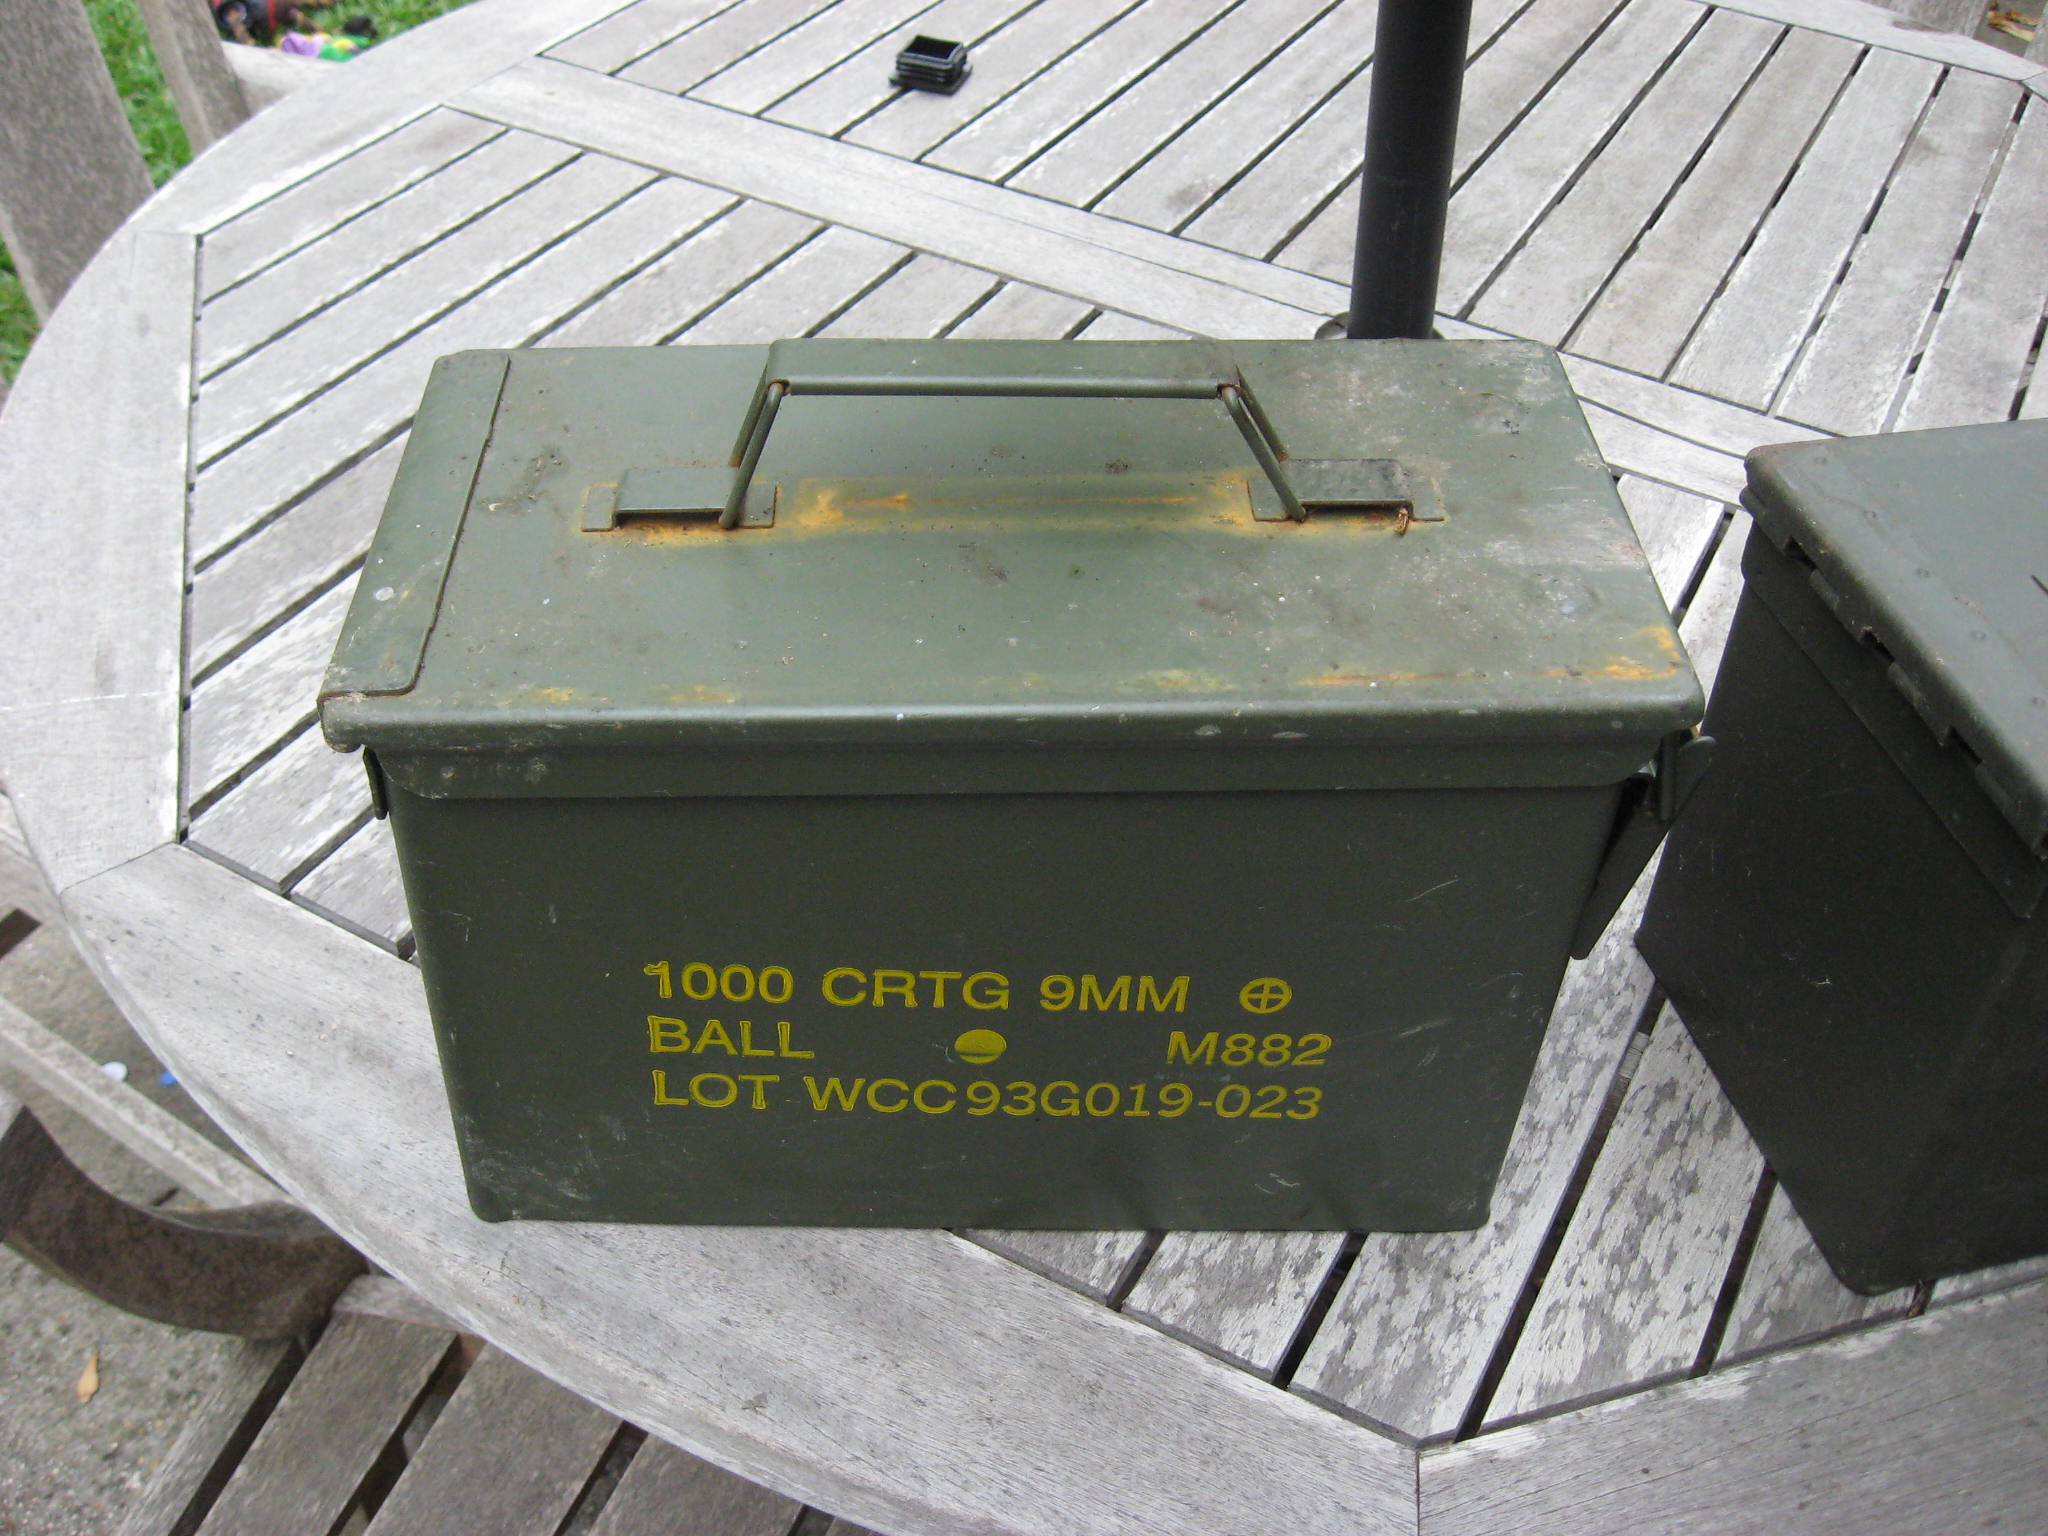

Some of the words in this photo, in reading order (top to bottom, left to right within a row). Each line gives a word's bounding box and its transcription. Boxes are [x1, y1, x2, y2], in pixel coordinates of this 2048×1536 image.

[642, 960, 795, 1004] 1000
[821, 967, 1011, 1012] CRTG
[1039, 973, 1191, 1014] 9MM
[647, 1014, 816, 1060] BALL
[1166, 1031, 1333, 1067] M882
[652, 1069, 780, 1111] LOT
[804, 1076, 1324, 1120] WCC93G019-023
